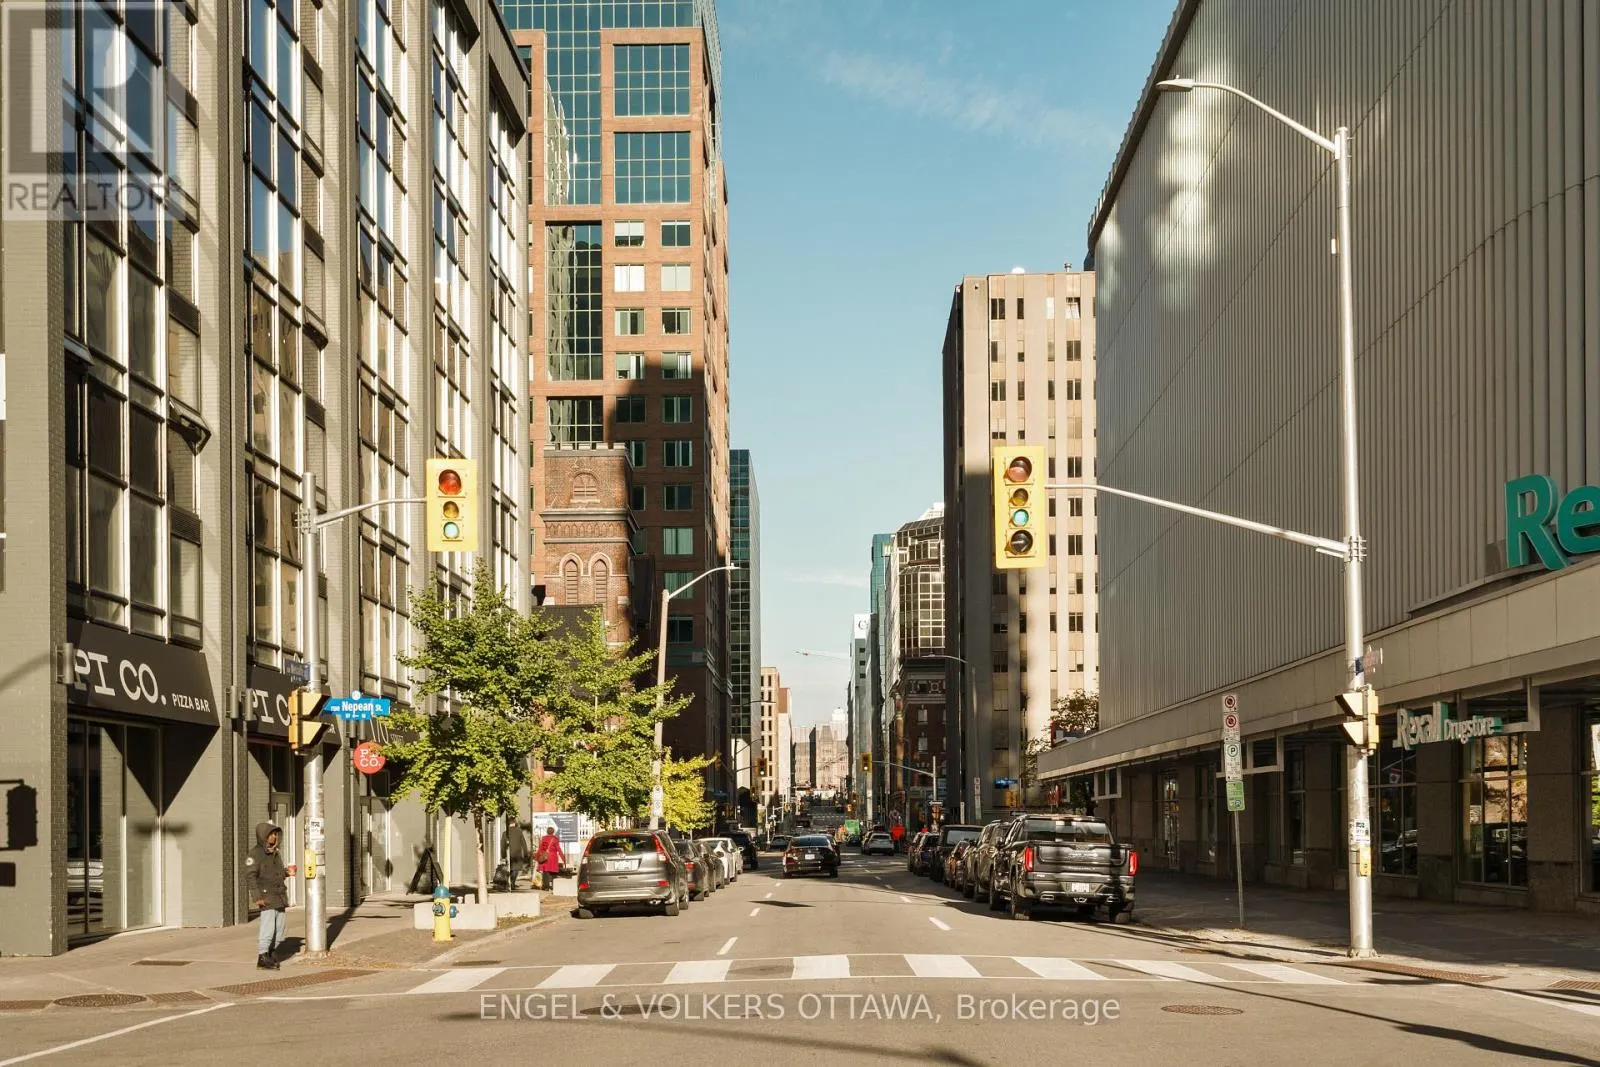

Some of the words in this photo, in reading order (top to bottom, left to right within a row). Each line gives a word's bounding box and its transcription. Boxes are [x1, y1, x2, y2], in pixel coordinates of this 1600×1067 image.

[74, 649, 115, 696] PI
[119, 659, 166, 705] CO.
[172, 692, 194, 710] PIZZA
[194, 697, 210, 712] BAR
[341, 701, 373, 714] Nepean
[1392, 701, 1442, 750] Rexall
[1444, 715, 1496, 744] Drugstore
[360, 758, 381, 767] CO.
